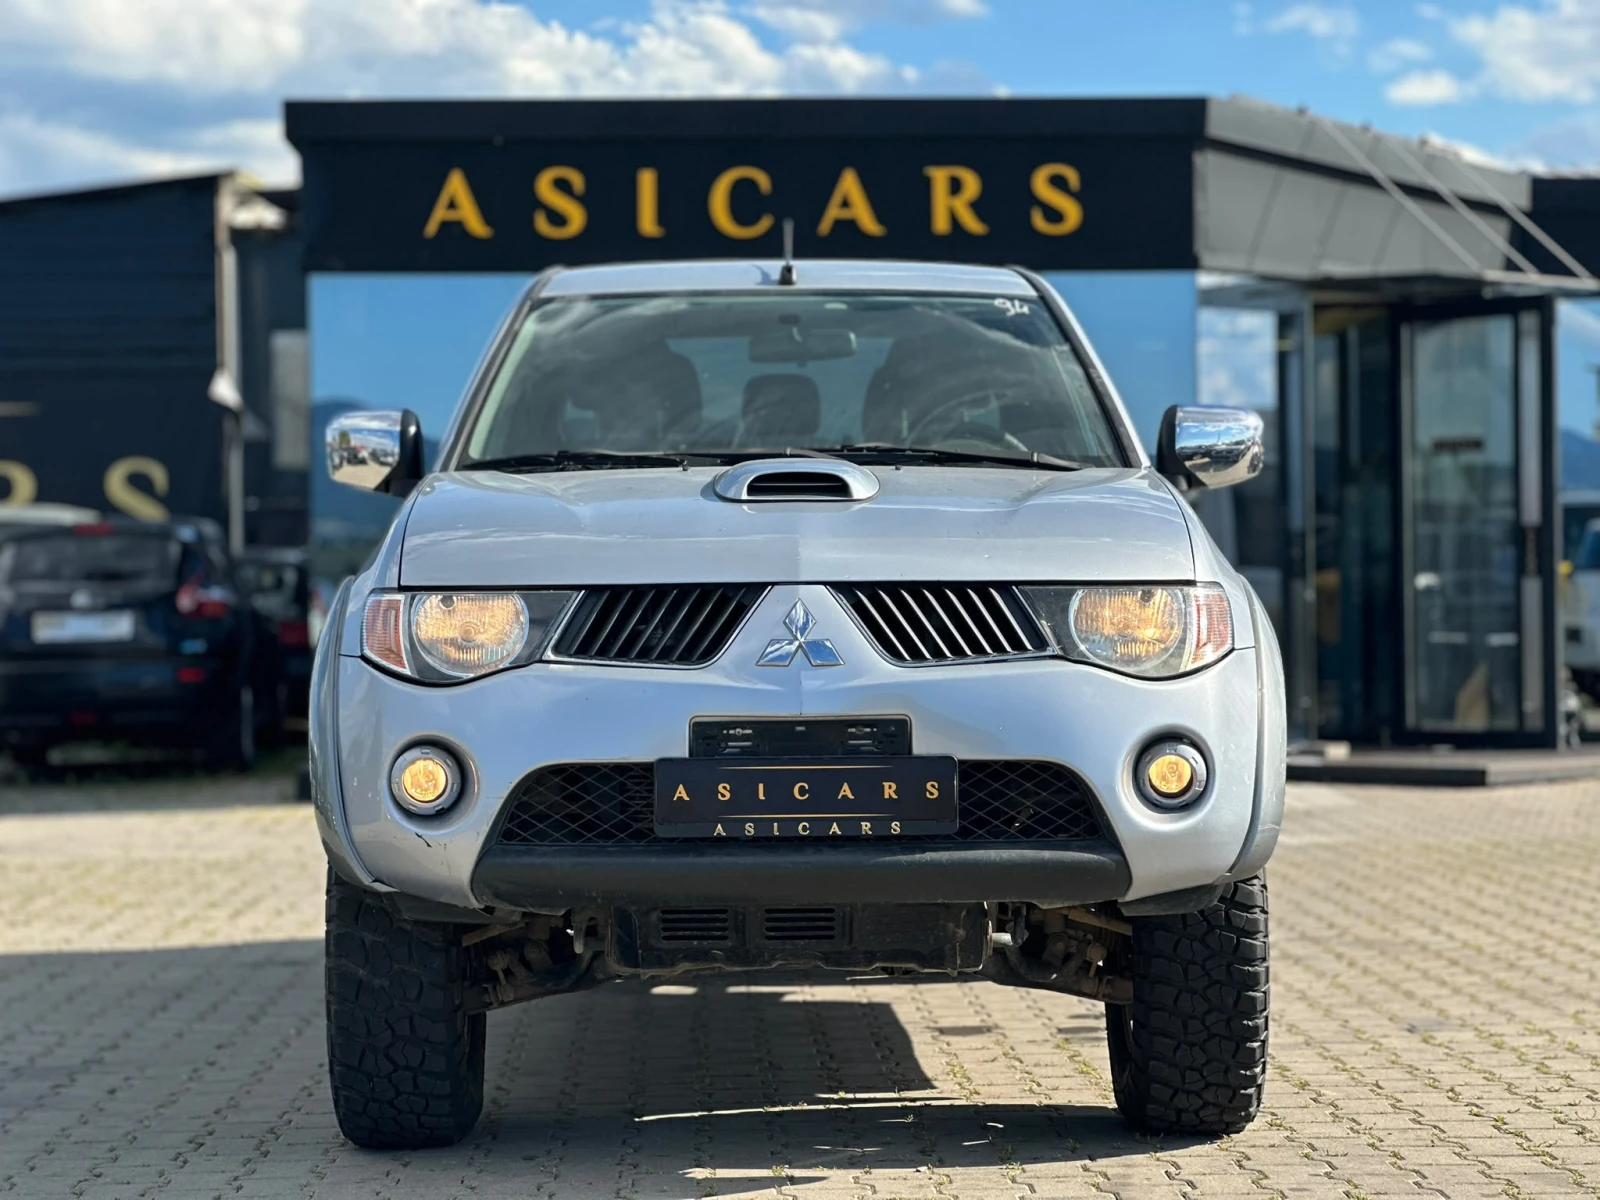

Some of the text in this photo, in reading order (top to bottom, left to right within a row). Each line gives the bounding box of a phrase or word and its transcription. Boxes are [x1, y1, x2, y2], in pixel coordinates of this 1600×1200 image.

[422, 162, 1085, 241] ASICARS
[673, 781, 940, 801] ASICARS
[713, 821, 901, 837] ASICARS
